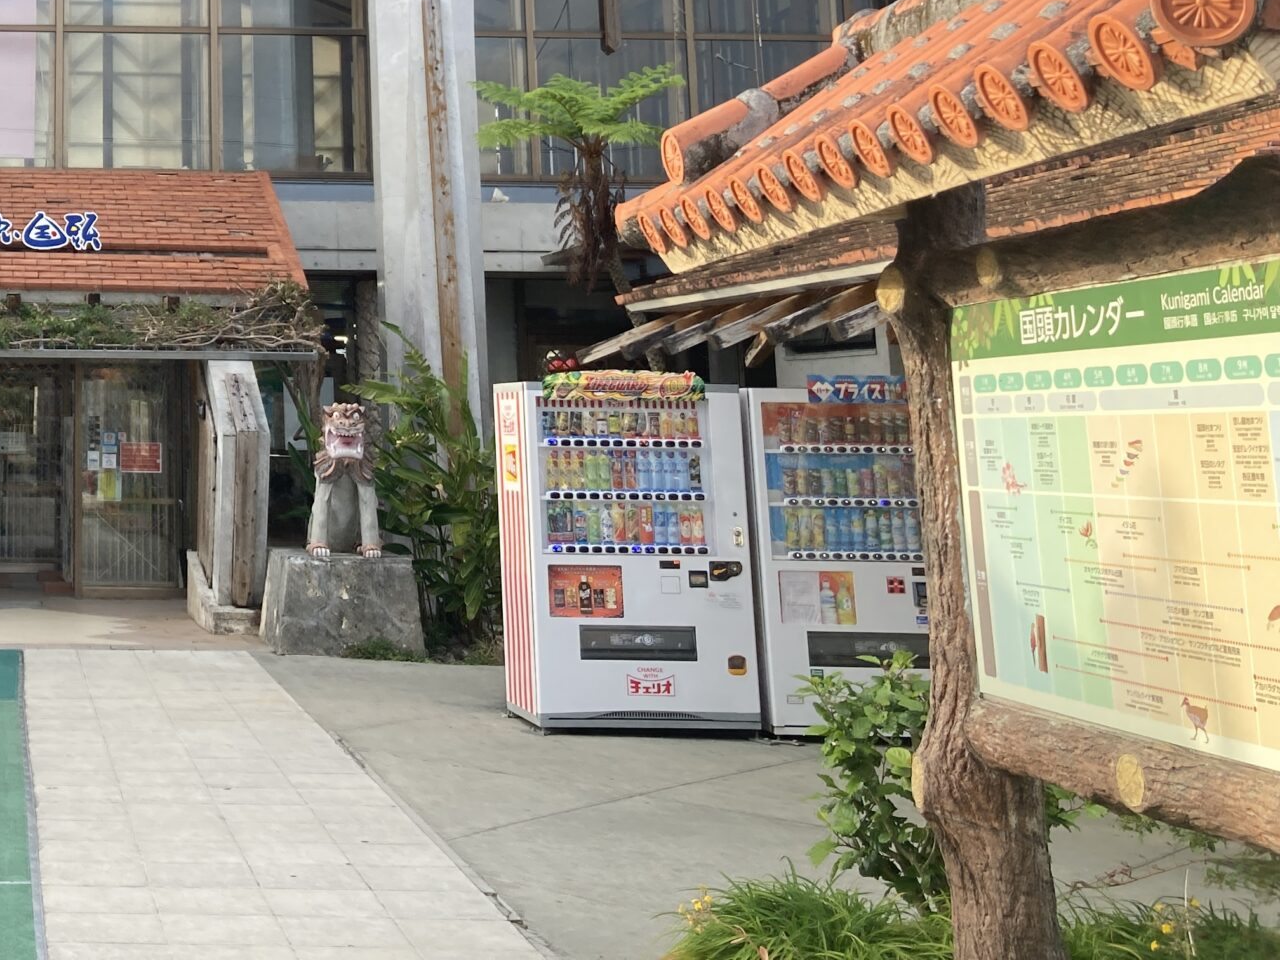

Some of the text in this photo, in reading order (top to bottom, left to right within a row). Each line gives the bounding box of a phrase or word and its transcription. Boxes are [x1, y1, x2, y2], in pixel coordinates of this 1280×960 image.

[1161, 283, 1265, 311] Kunigami Calendar
[1019, 296, 1145, 345] 国頭カレンダー
[834, 382, 882, 400] プライス
[630, 679, 672, 694] チェリオ
